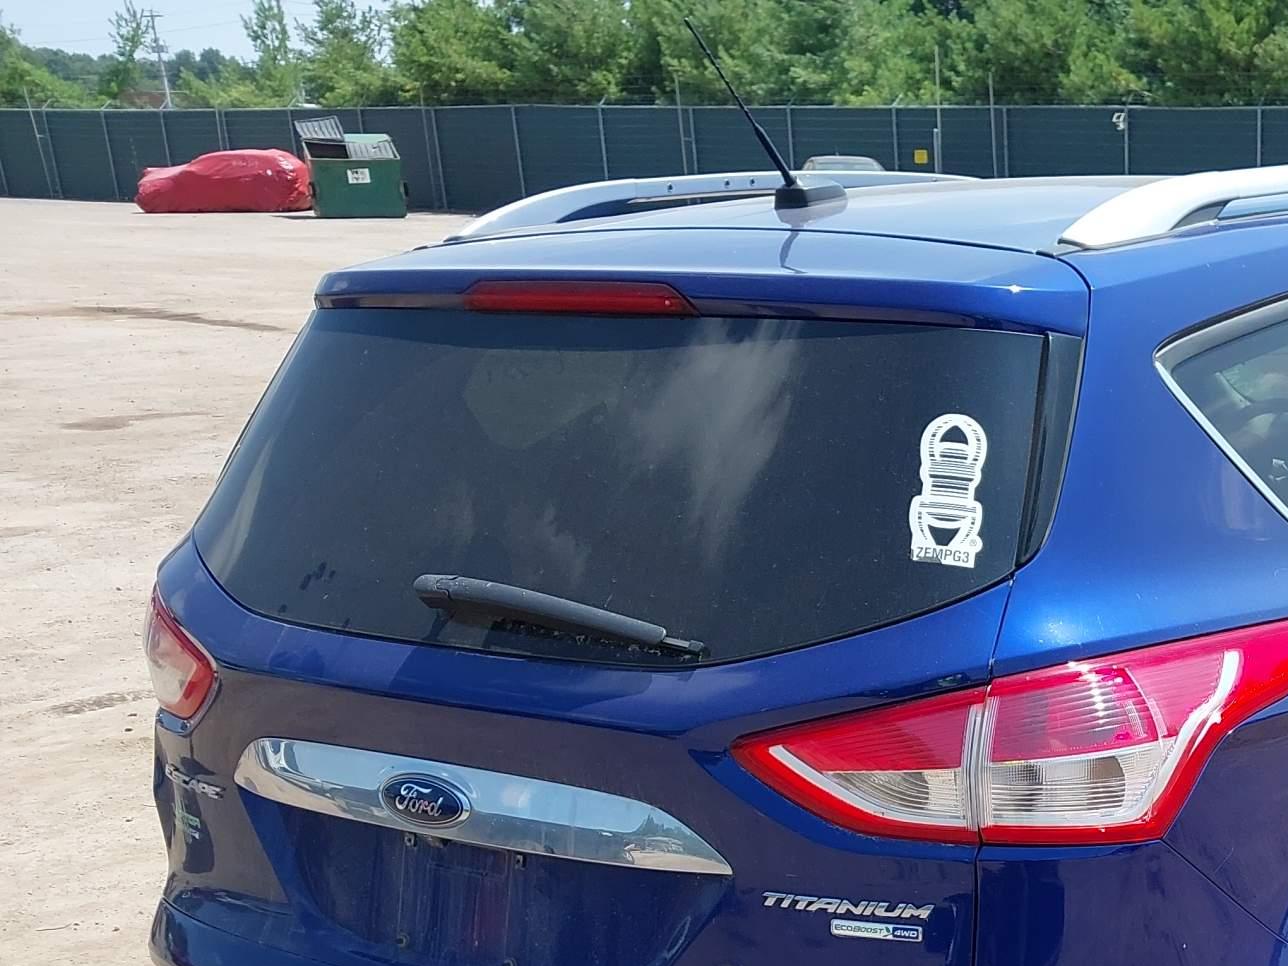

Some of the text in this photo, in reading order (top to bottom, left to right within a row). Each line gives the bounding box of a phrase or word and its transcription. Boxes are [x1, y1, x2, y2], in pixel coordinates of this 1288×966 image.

[395, 783, 444, 817] Ford
[762, 891, 936, 920] TITANIUM
[893, 930, 918, 938] 4WD
